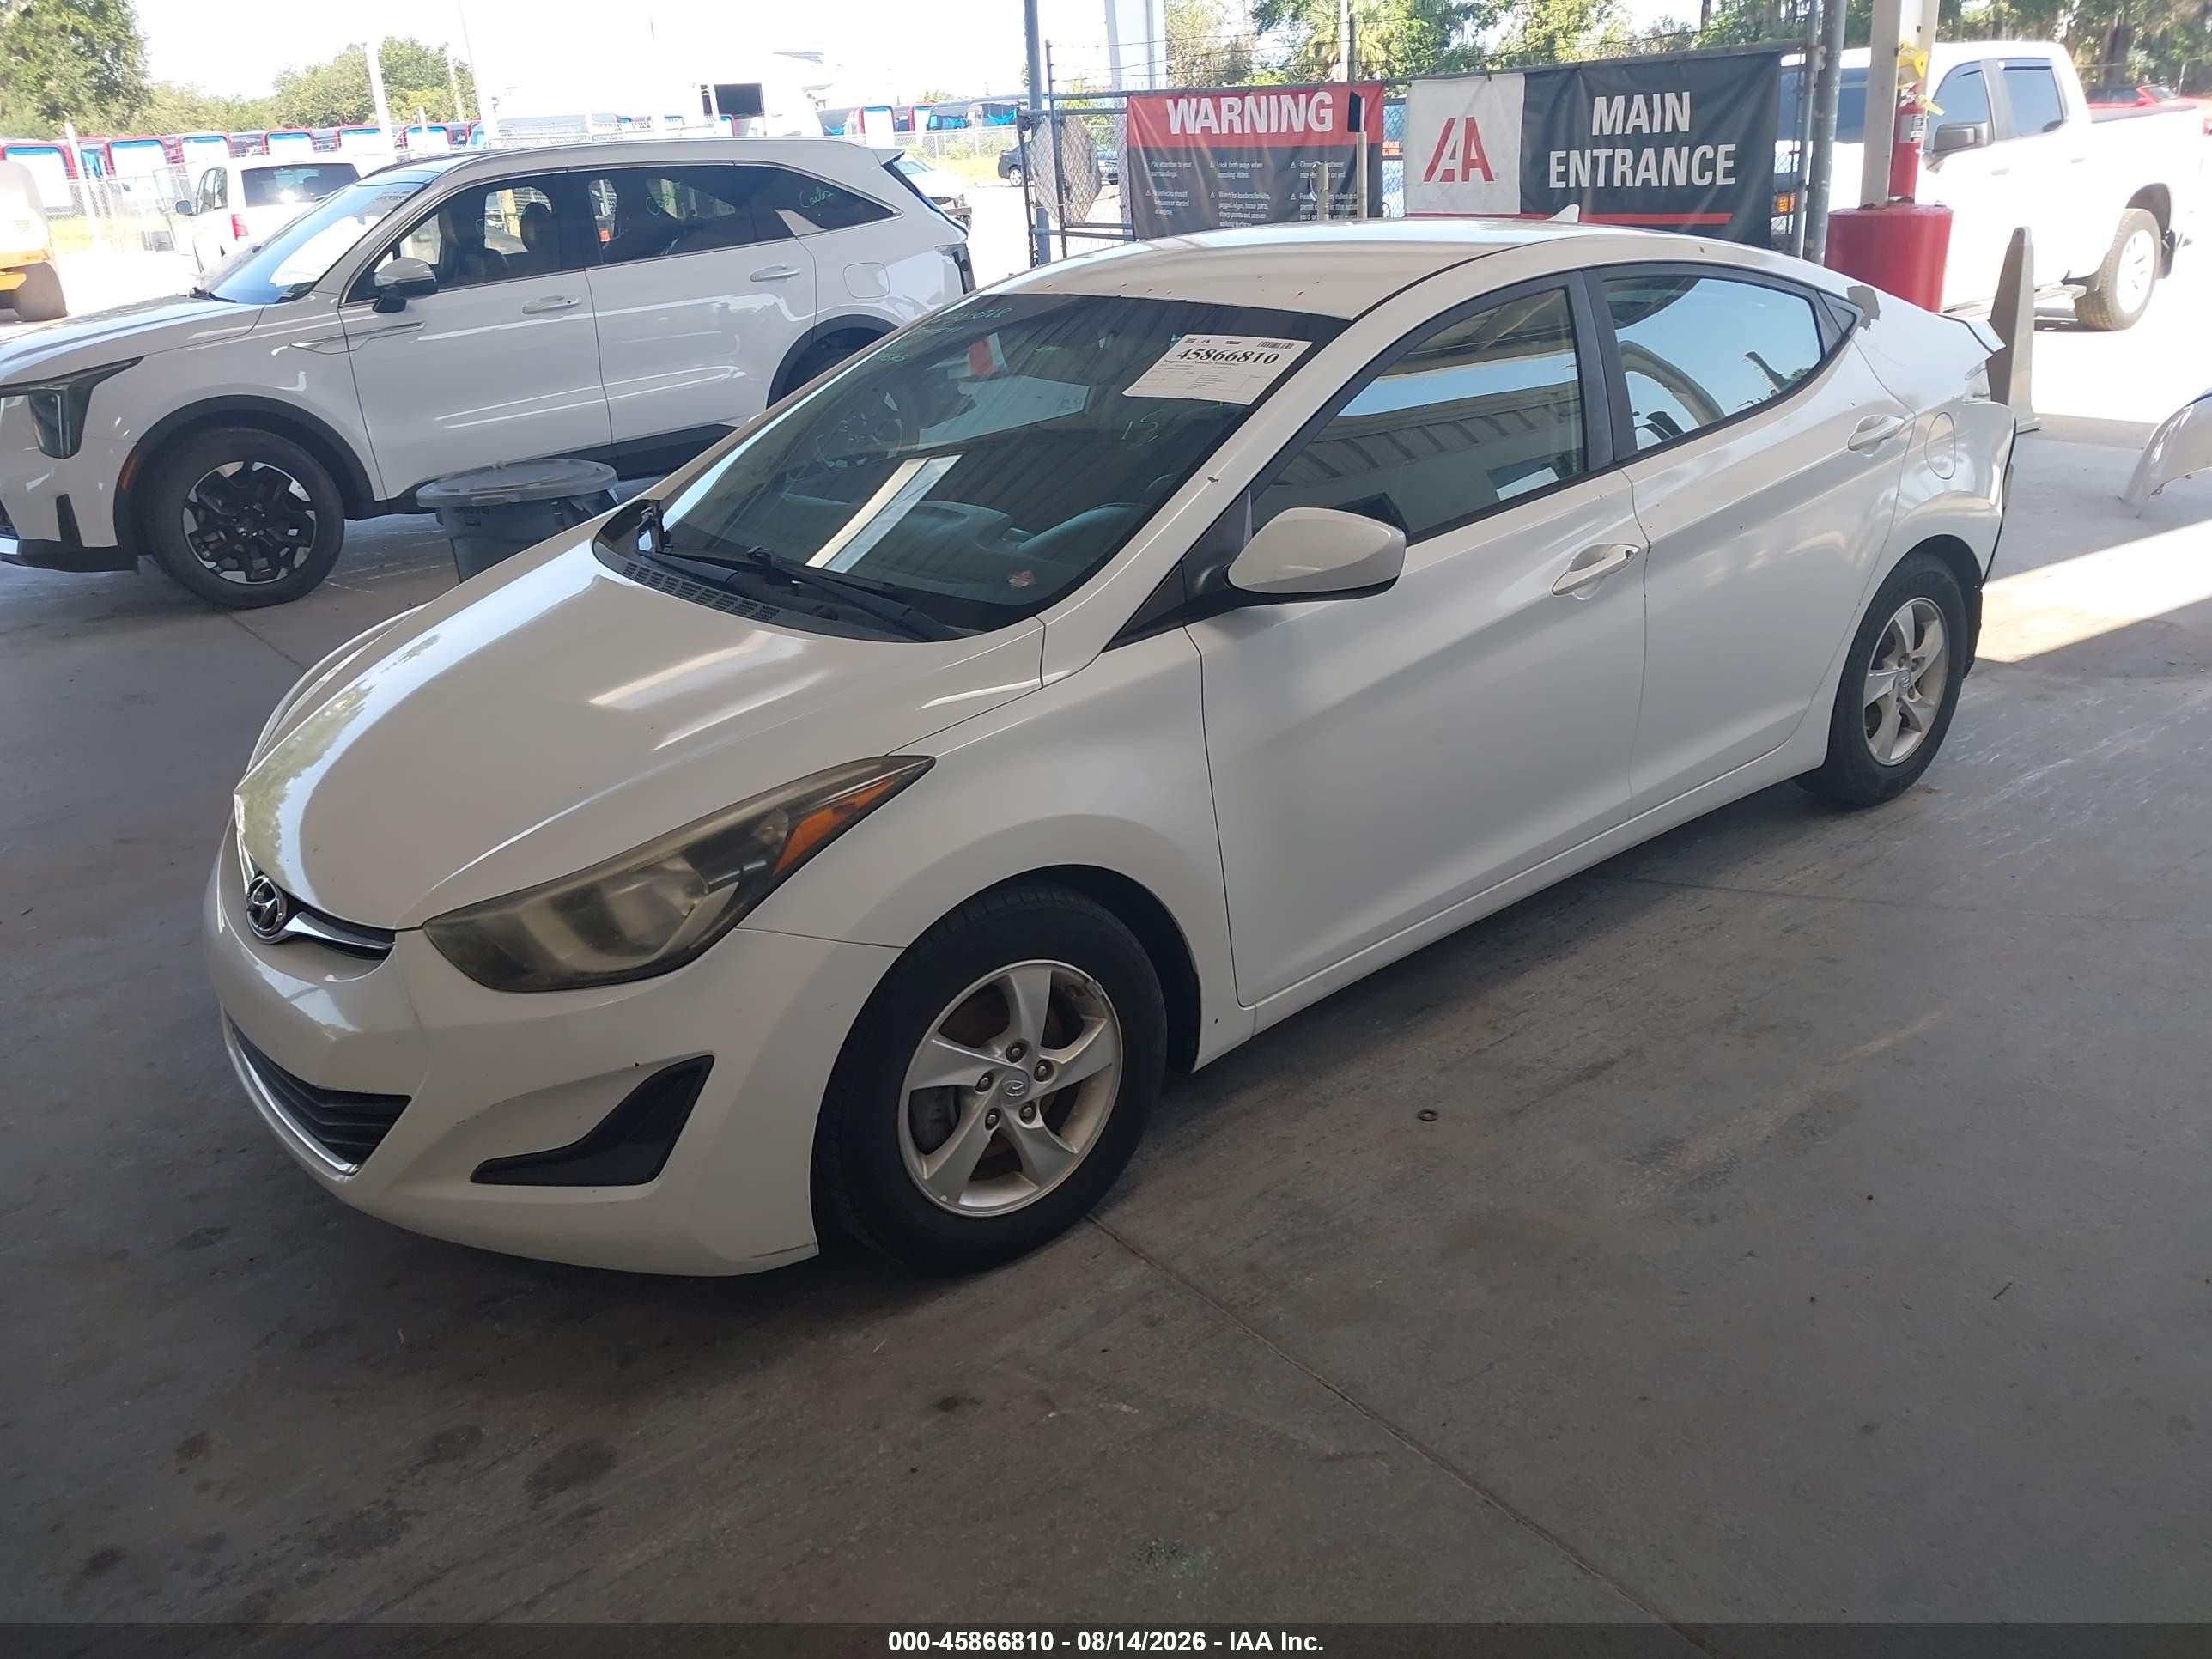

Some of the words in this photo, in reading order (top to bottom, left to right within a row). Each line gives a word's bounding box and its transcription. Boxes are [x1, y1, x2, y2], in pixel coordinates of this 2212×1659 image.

[1166, 91, 1333, 135] WARNING
[1591, 91, 1690, 136] MAIN
[1548, 143, 1736, 189] ENTRANCE
[1176, 348, 1279, 365] 45866810
